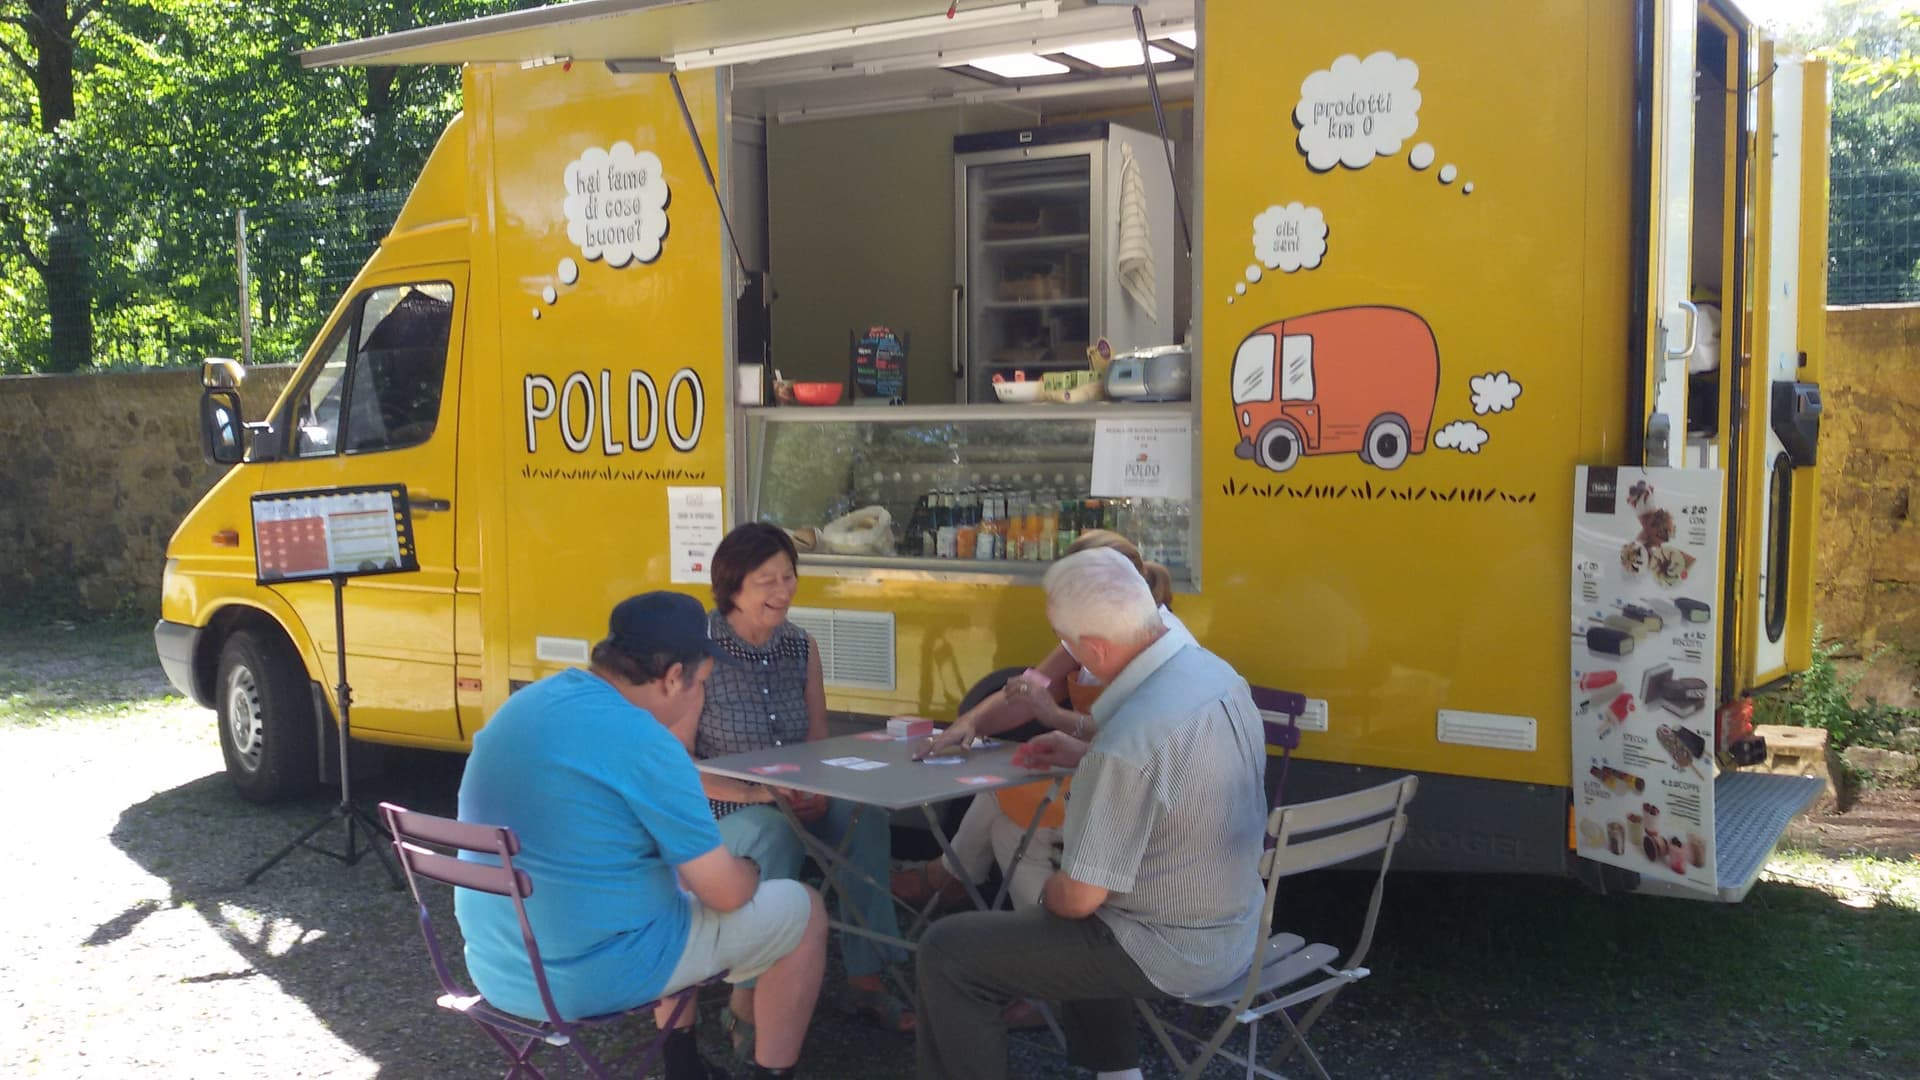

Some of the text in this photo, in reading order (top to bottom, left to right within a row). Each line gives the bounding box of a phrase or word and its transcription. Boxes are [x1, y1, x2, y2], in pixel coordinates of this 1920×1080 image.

[1313, 91, 1391, 125] prodotti
[1328, 116, 1374, 139] km 0
[576, 165, 647, 195] hai fame
[584, 193, 641, 220] di cose
[586, 219, 641, 248] buone?
[1275, 220, 1299, 237] cibi
[523, 367, 705, 456] POLDO
[1125, 463, 1161, 478] POLDO
